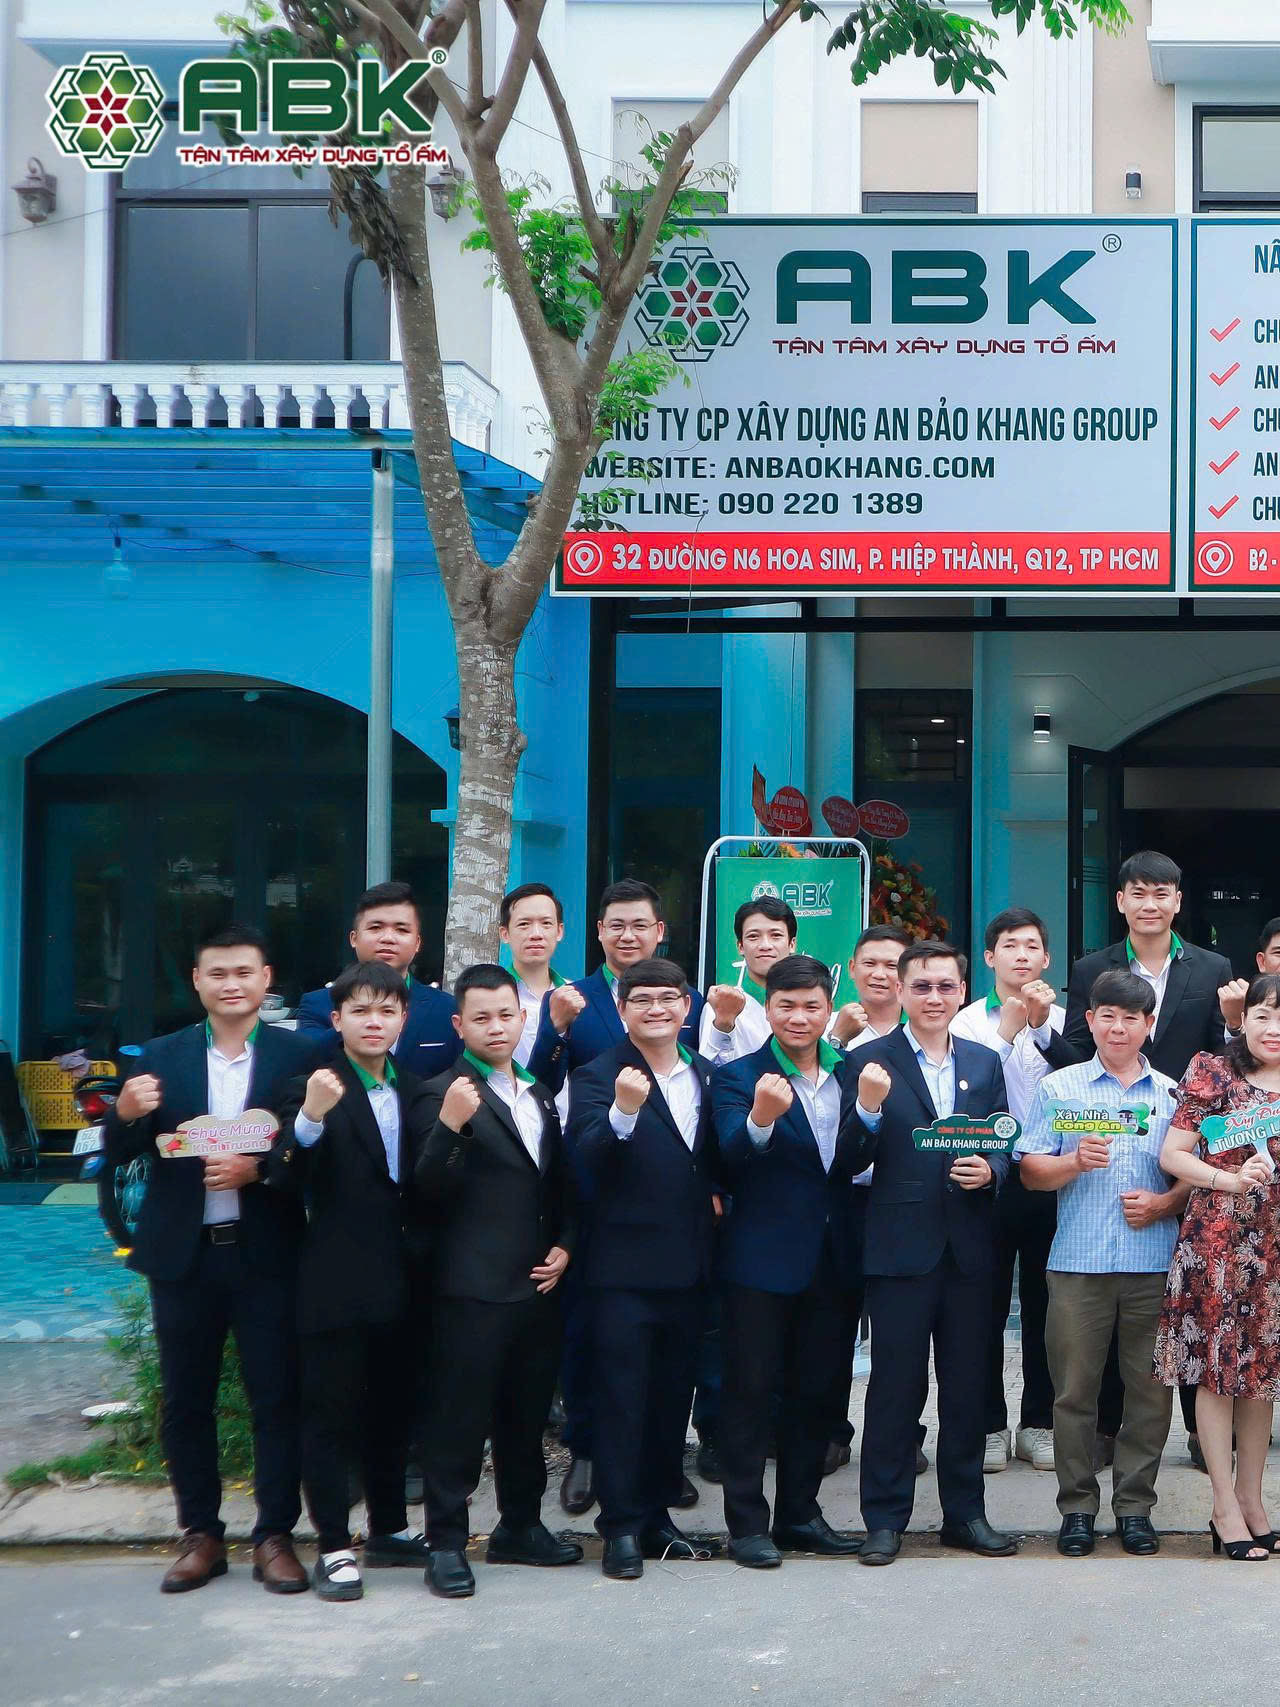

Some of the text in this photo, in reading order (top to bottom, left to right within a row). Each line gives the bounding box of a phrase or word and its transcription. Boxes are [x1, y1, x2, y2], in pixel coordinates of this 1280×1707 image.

[776, 249, 1098, 325] ABK
[772, 334, 1115, 356] TẬN TÂM XÂY DỰNG TỔ ẤM
[1254, 365, 1278, 389] AN
[656, 397, 1158, 448] TY CP XÂY DỰNG AN BẢO KHANG GROUP
[584, 457, 995, 479] WEBSITE: ANBAOKHANG.COM
[1254, 453, 1278, 477] AN
[580, 492, 923, 515] HOTLINE: 090 220 1389
[613, 542, 1158, 576] 32 ĐƯỜNG N6 HOA SIM, P. HIỆP THÀNH, Q12, TP HCM
[1249, 549, 1268, 571] B2
[1054, 1120, 1122, 1131] Long An
[1055, 1108, 1109, 1123] Xây Nhà
[921, 1136, 1008, 1149] AN BẢO KHANG GROUP
[1215, 1126, 1267, 1152] TƯƠNG
